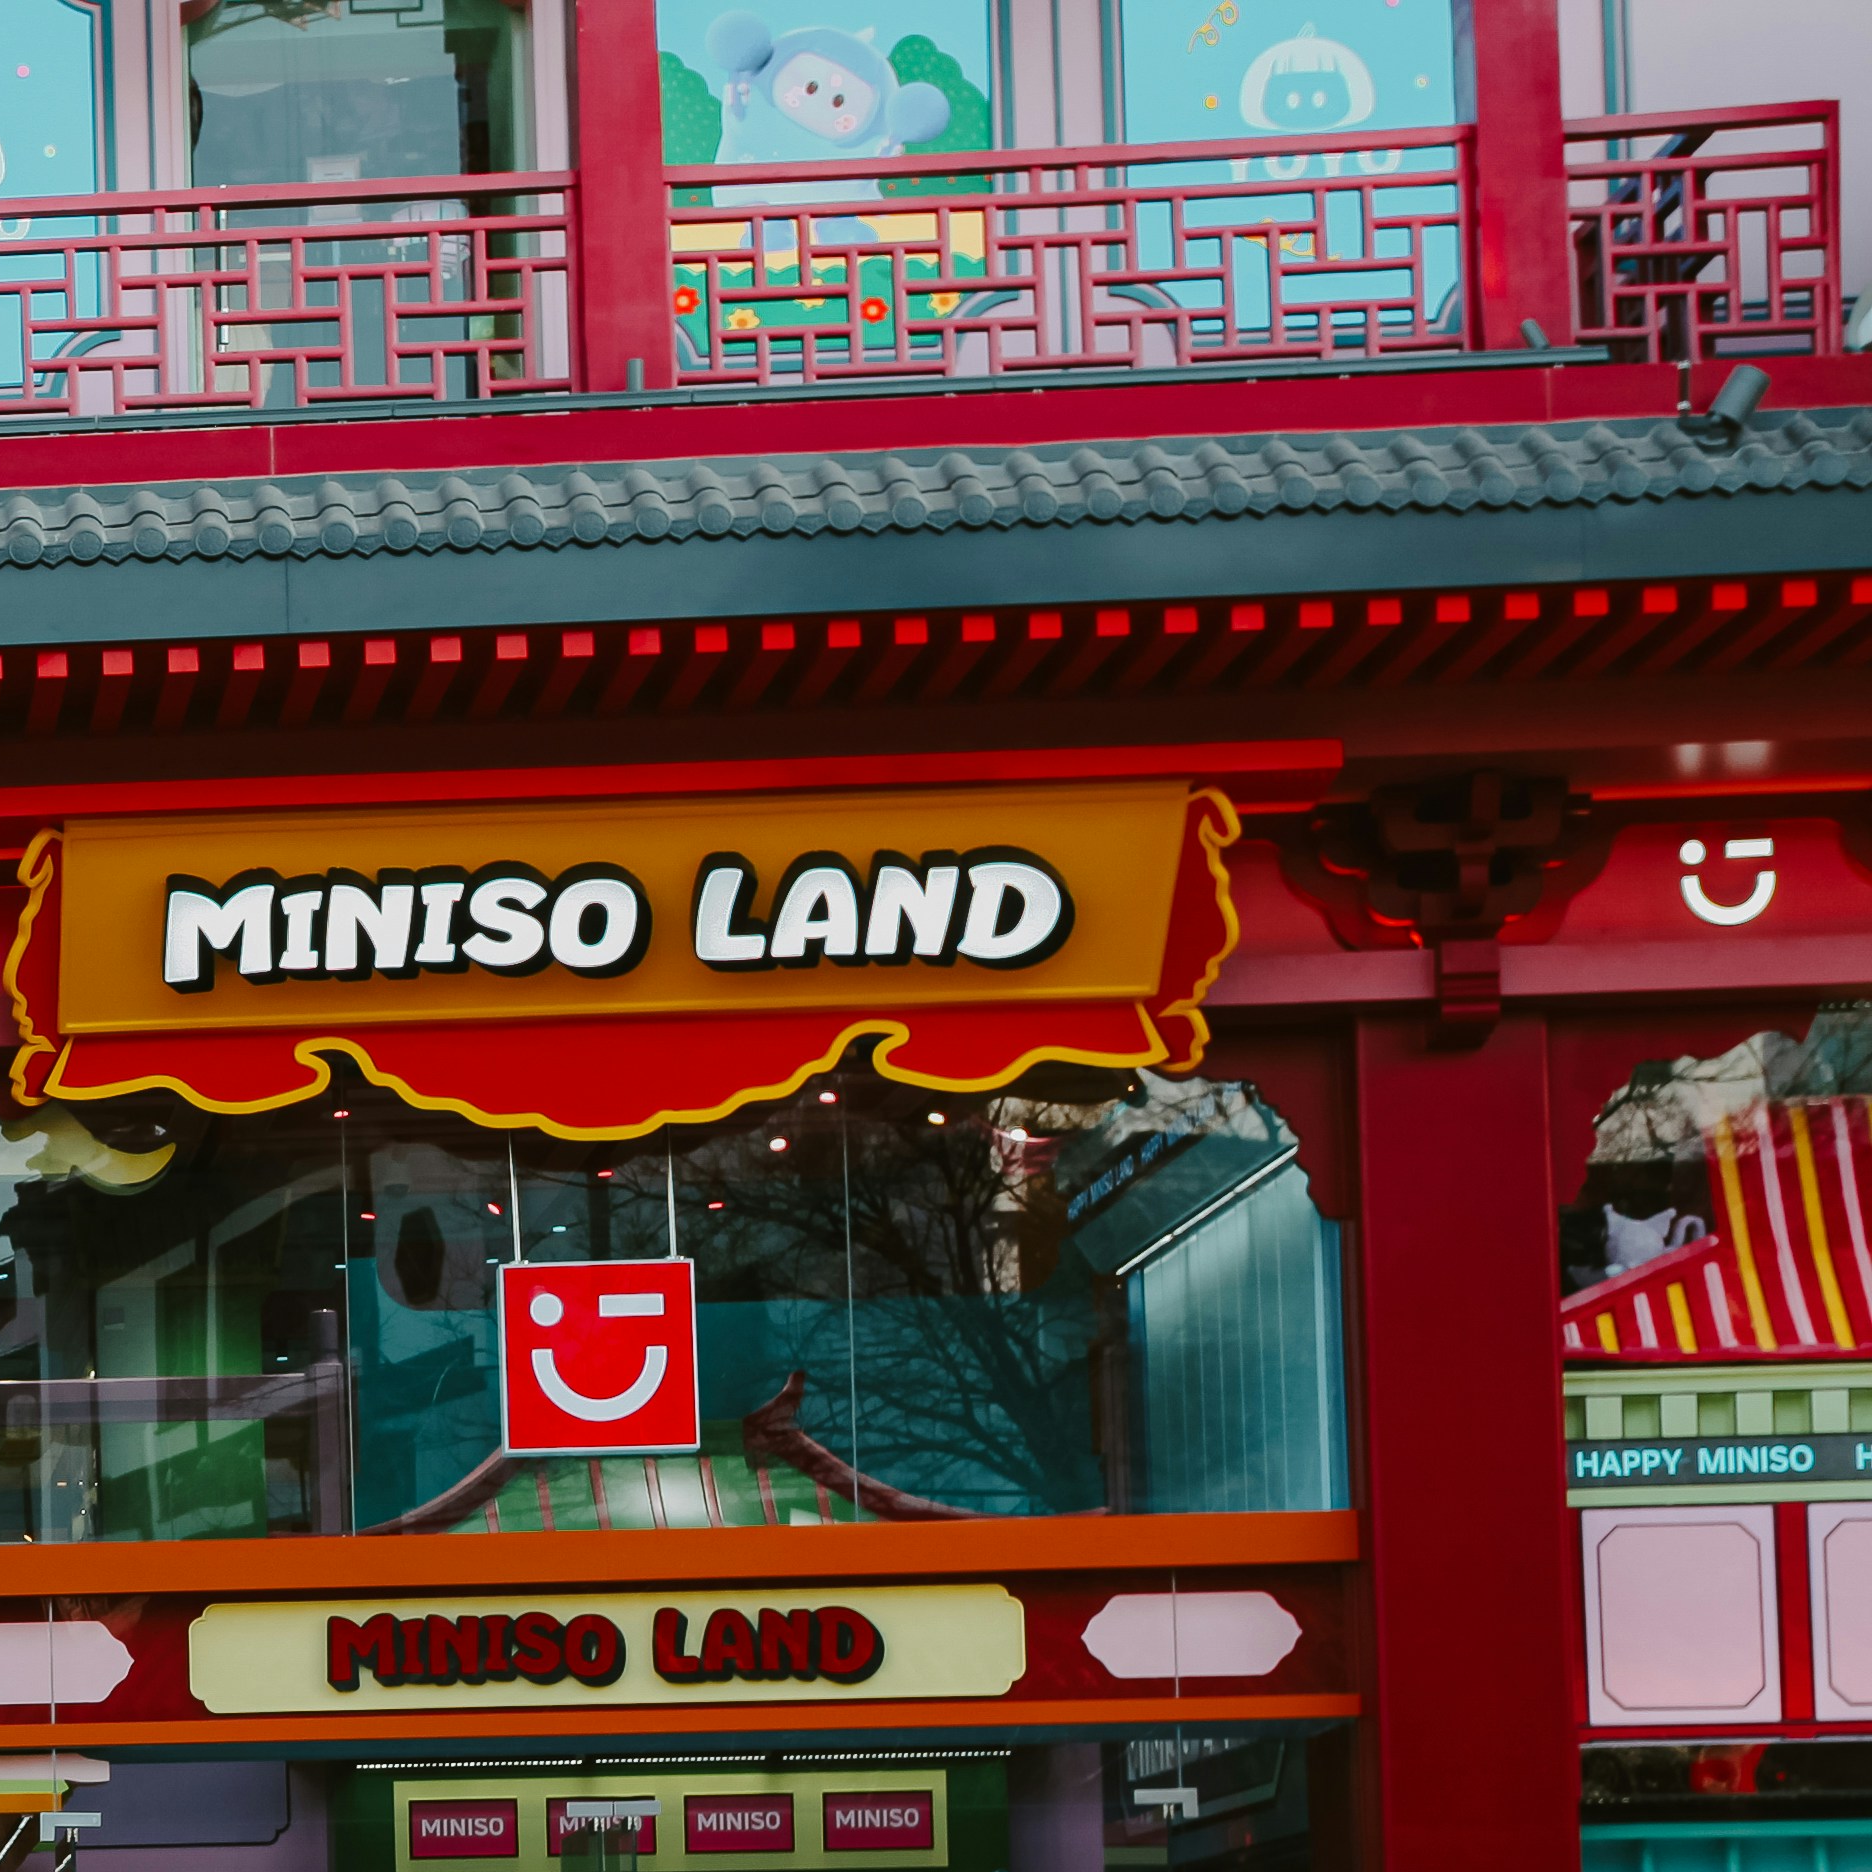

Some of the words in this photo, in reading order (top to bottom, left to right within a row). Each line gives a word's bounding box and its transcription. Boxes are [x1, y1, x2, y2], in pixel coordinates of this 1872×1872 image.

[162, 868, 644, 989] MINISO
[694, 852, 1068, 966] LAND
[1575, 1448, 1682, 1479] HAPPY
[1696, 1444, 1816, 1475] MINISO
[326, 1611, 627, 1691] MINISO
[652, 1606, 885, 1685] LAND
[420, 1817, 506, 1838] MINISO
[696, 1811, 782, 1832] MINISO
[834, 1807, 921, 1829] MINISO
